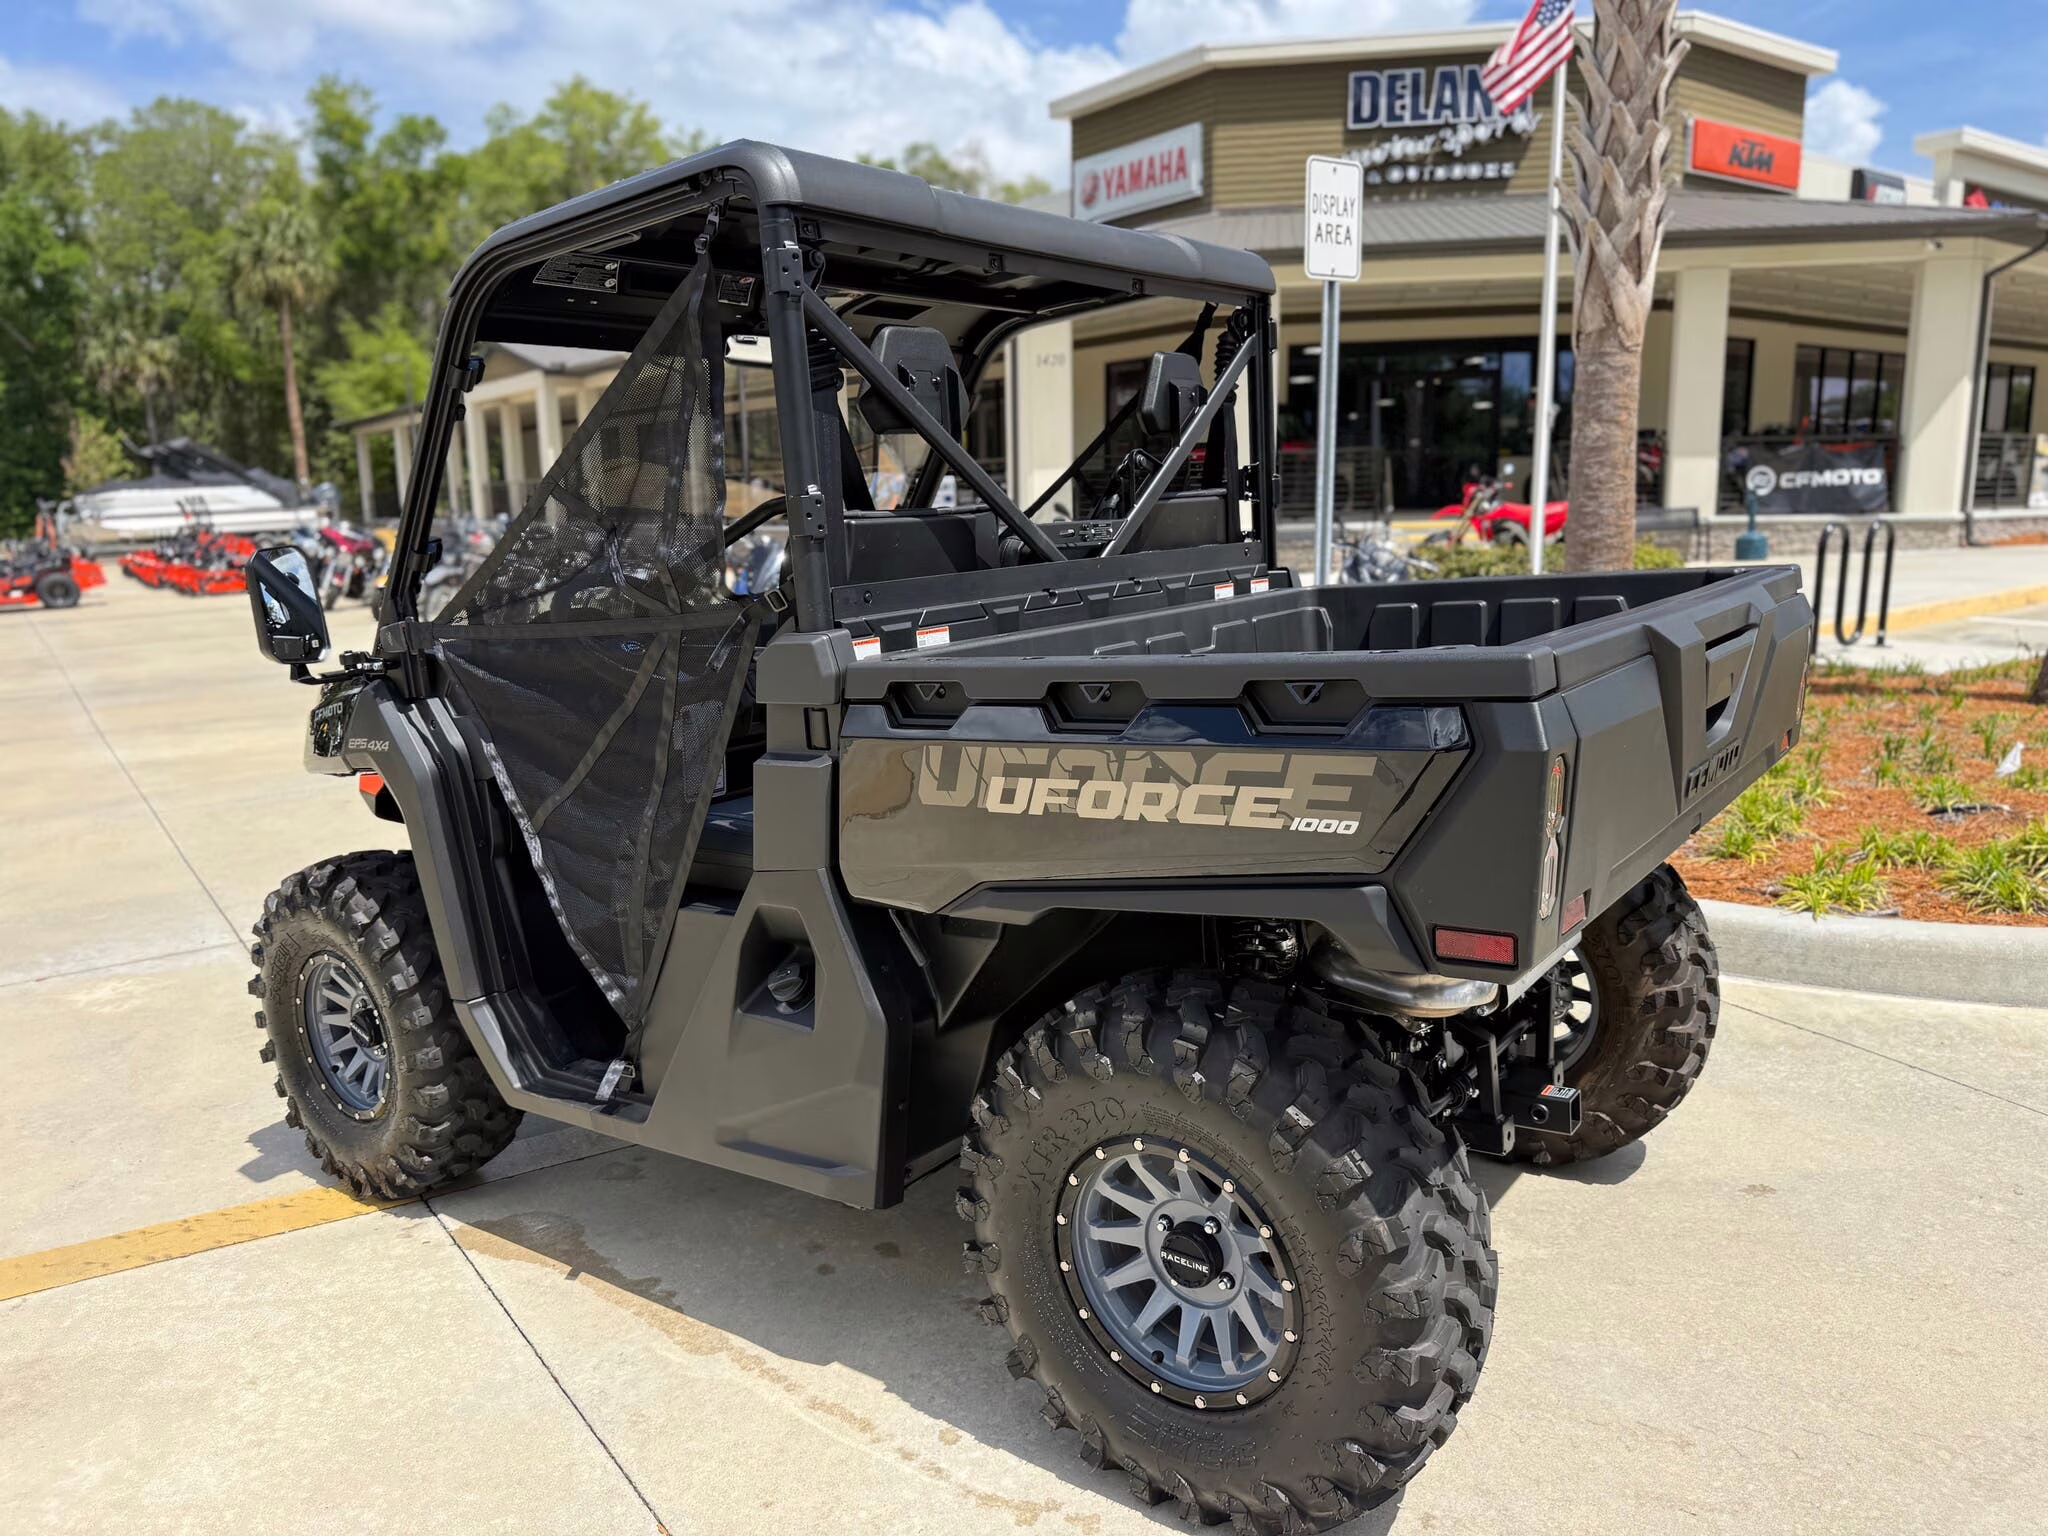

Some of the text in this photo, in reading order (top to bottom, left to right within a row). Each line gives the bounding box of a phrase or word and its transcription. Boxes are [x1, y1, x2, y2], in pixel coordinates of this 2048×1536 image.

[1347, 64, 1534, 130] DELAN
[1728, 138, 1774, 174] KTM
[1103, 145, 1188, 201] YAMAHA
[1312, 193, 1356, 218] DISPLAY
[1314, 221, 1353, 246] AREA
[1779, 468, 1882, 489] CFMOTO
[348, 738, 368, 749] EPS
[986, 776, 1359, 834] UFORCE 1000
[1063, 1097, 1126, 1136] 370
[1161, 1251, 1209, 1273] RACELINE
